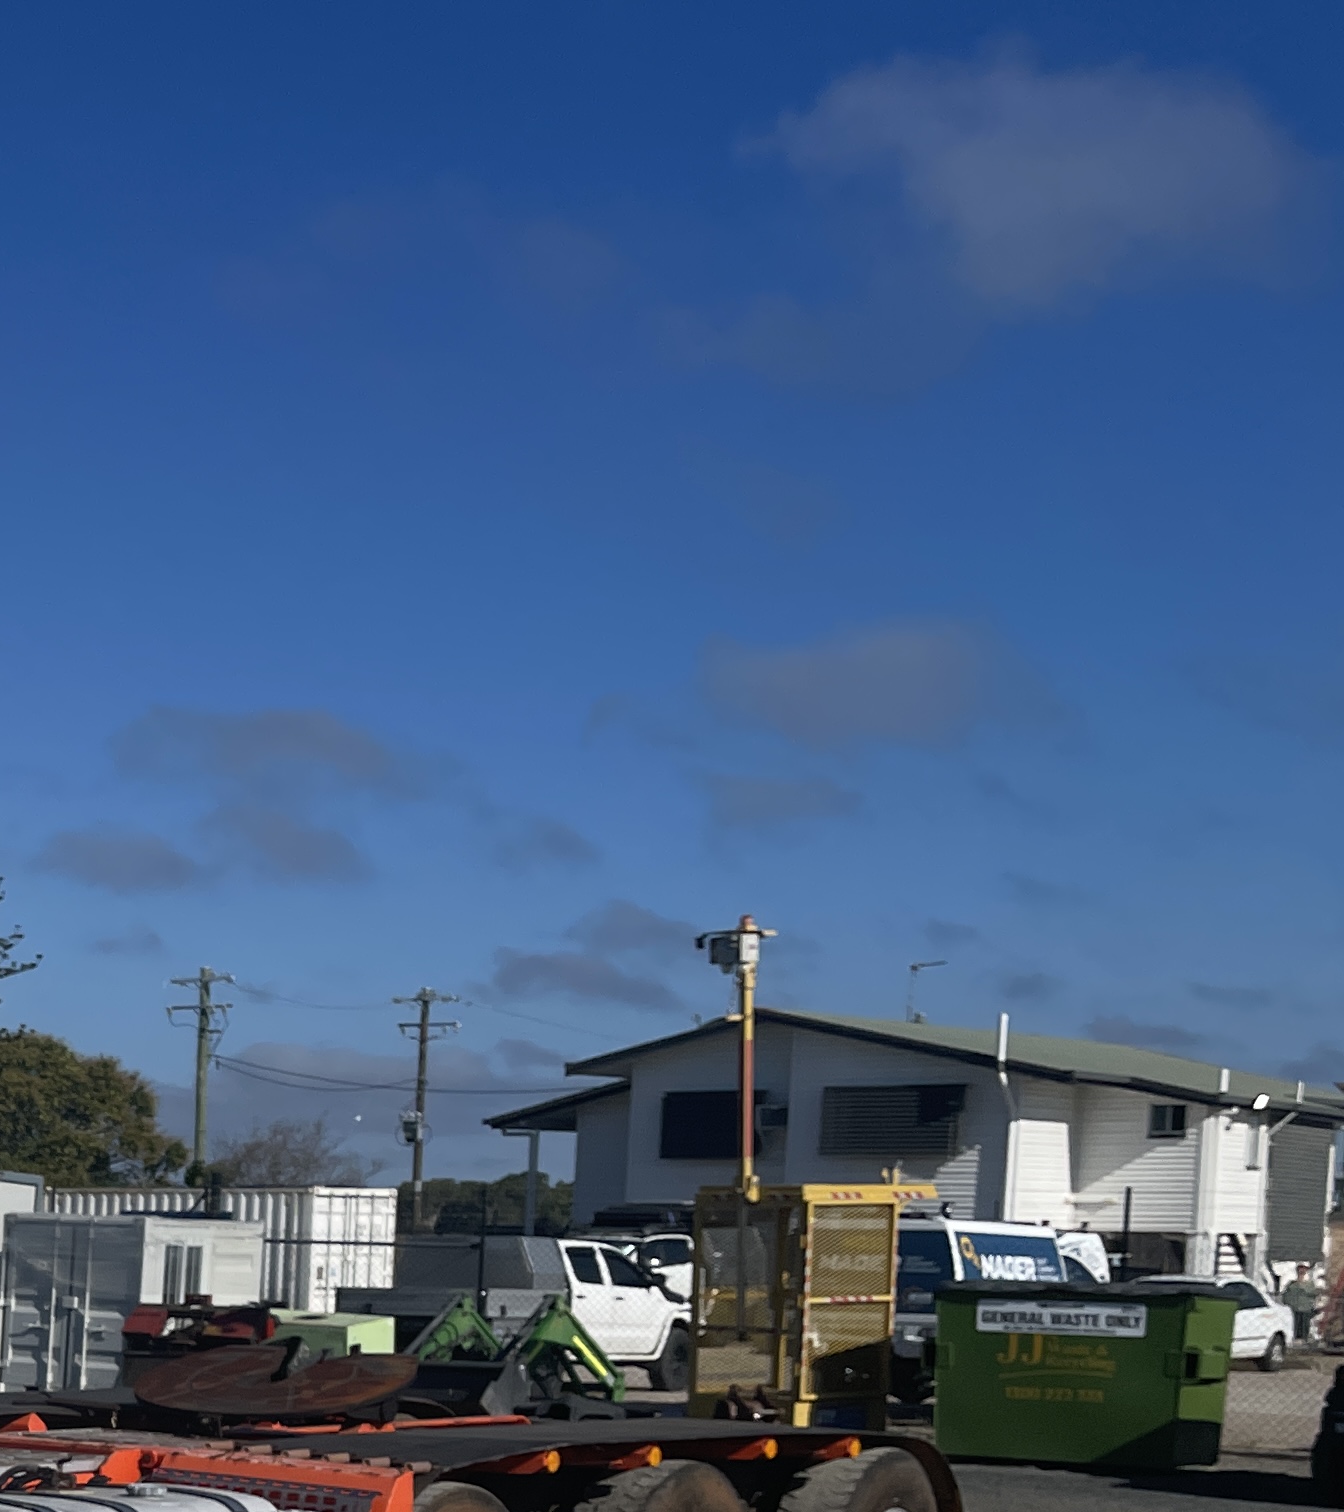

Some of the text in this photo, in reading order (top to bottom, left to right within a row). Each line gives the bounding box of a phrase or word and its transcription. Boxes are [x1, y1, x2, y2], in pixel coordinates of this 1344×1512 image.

[981, 1309, 1142, 1329] GENERAL WASTE ONLY
